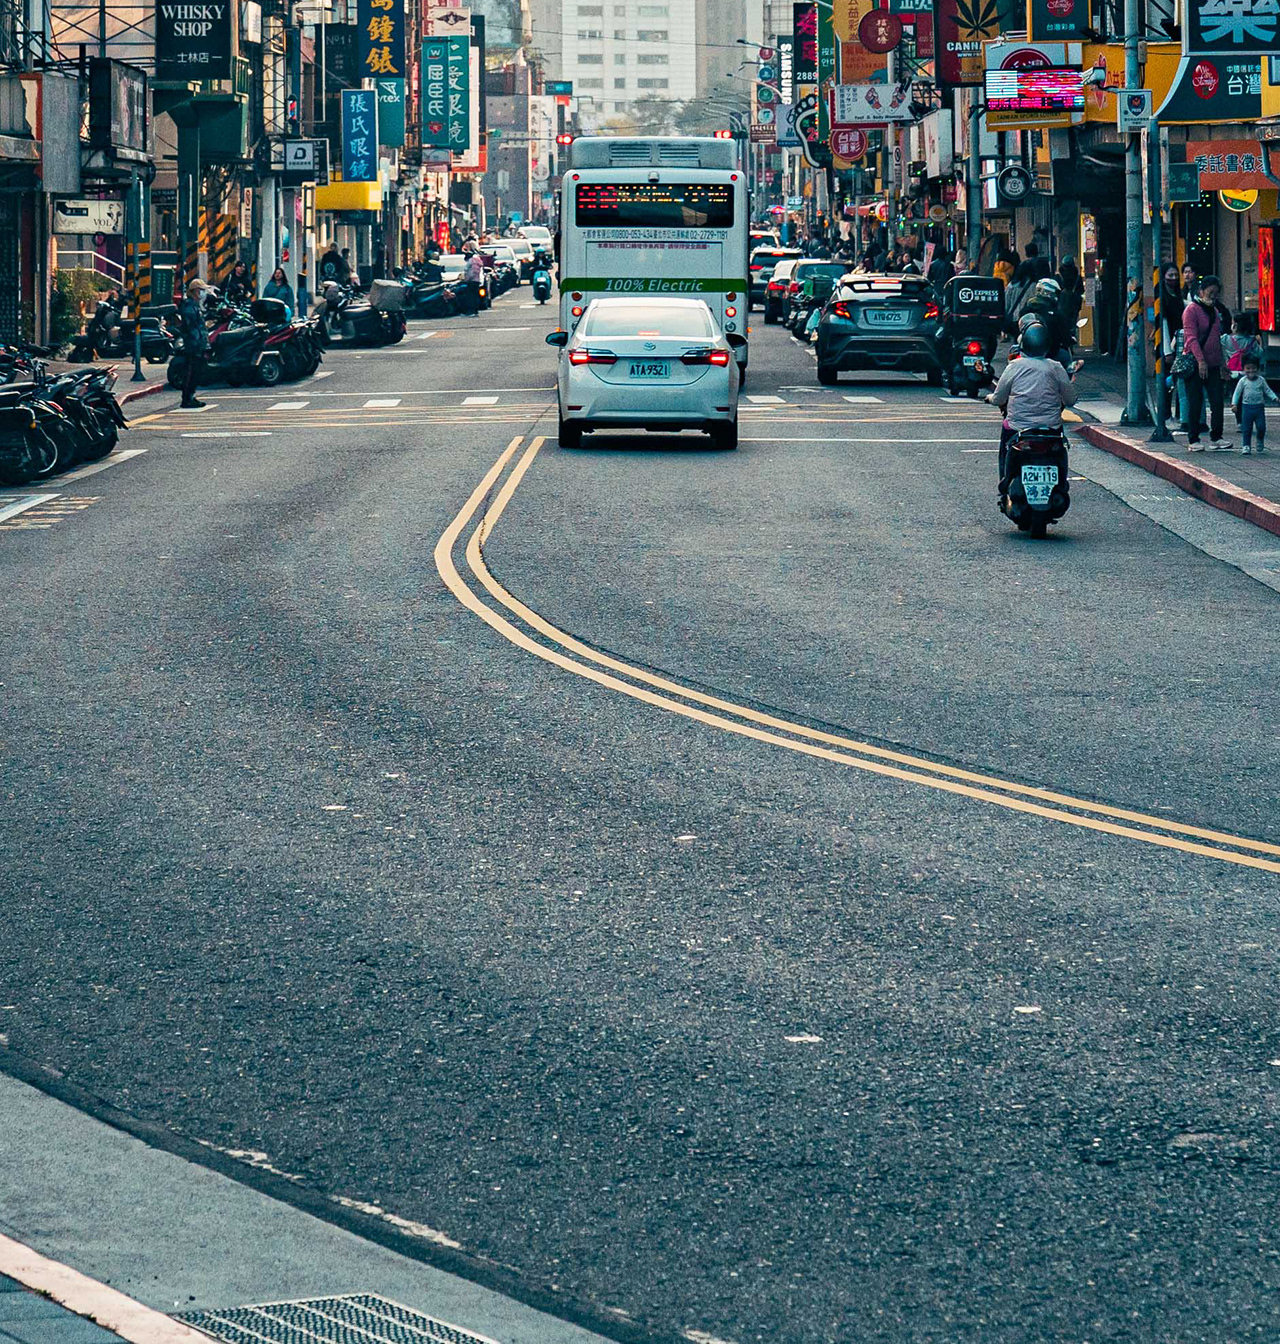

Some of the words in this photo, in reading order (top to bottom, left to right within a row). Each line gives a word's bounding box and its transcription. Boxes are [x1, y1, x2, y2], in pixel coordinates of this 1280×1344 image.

[161, 4, 225, 22] WHISKY
[173, 21, 213, 38] SHOP
[177, 52, 210, 64] 士林店
[427, 64, 444, 116] 屈臣氏
[349, 93, 370, 179] 張氏眼鏡
[605, 278, 645, 292] 100%
[647, 278, 704, 292] Electric
[630, 364, 667, 376] ATA-9321
